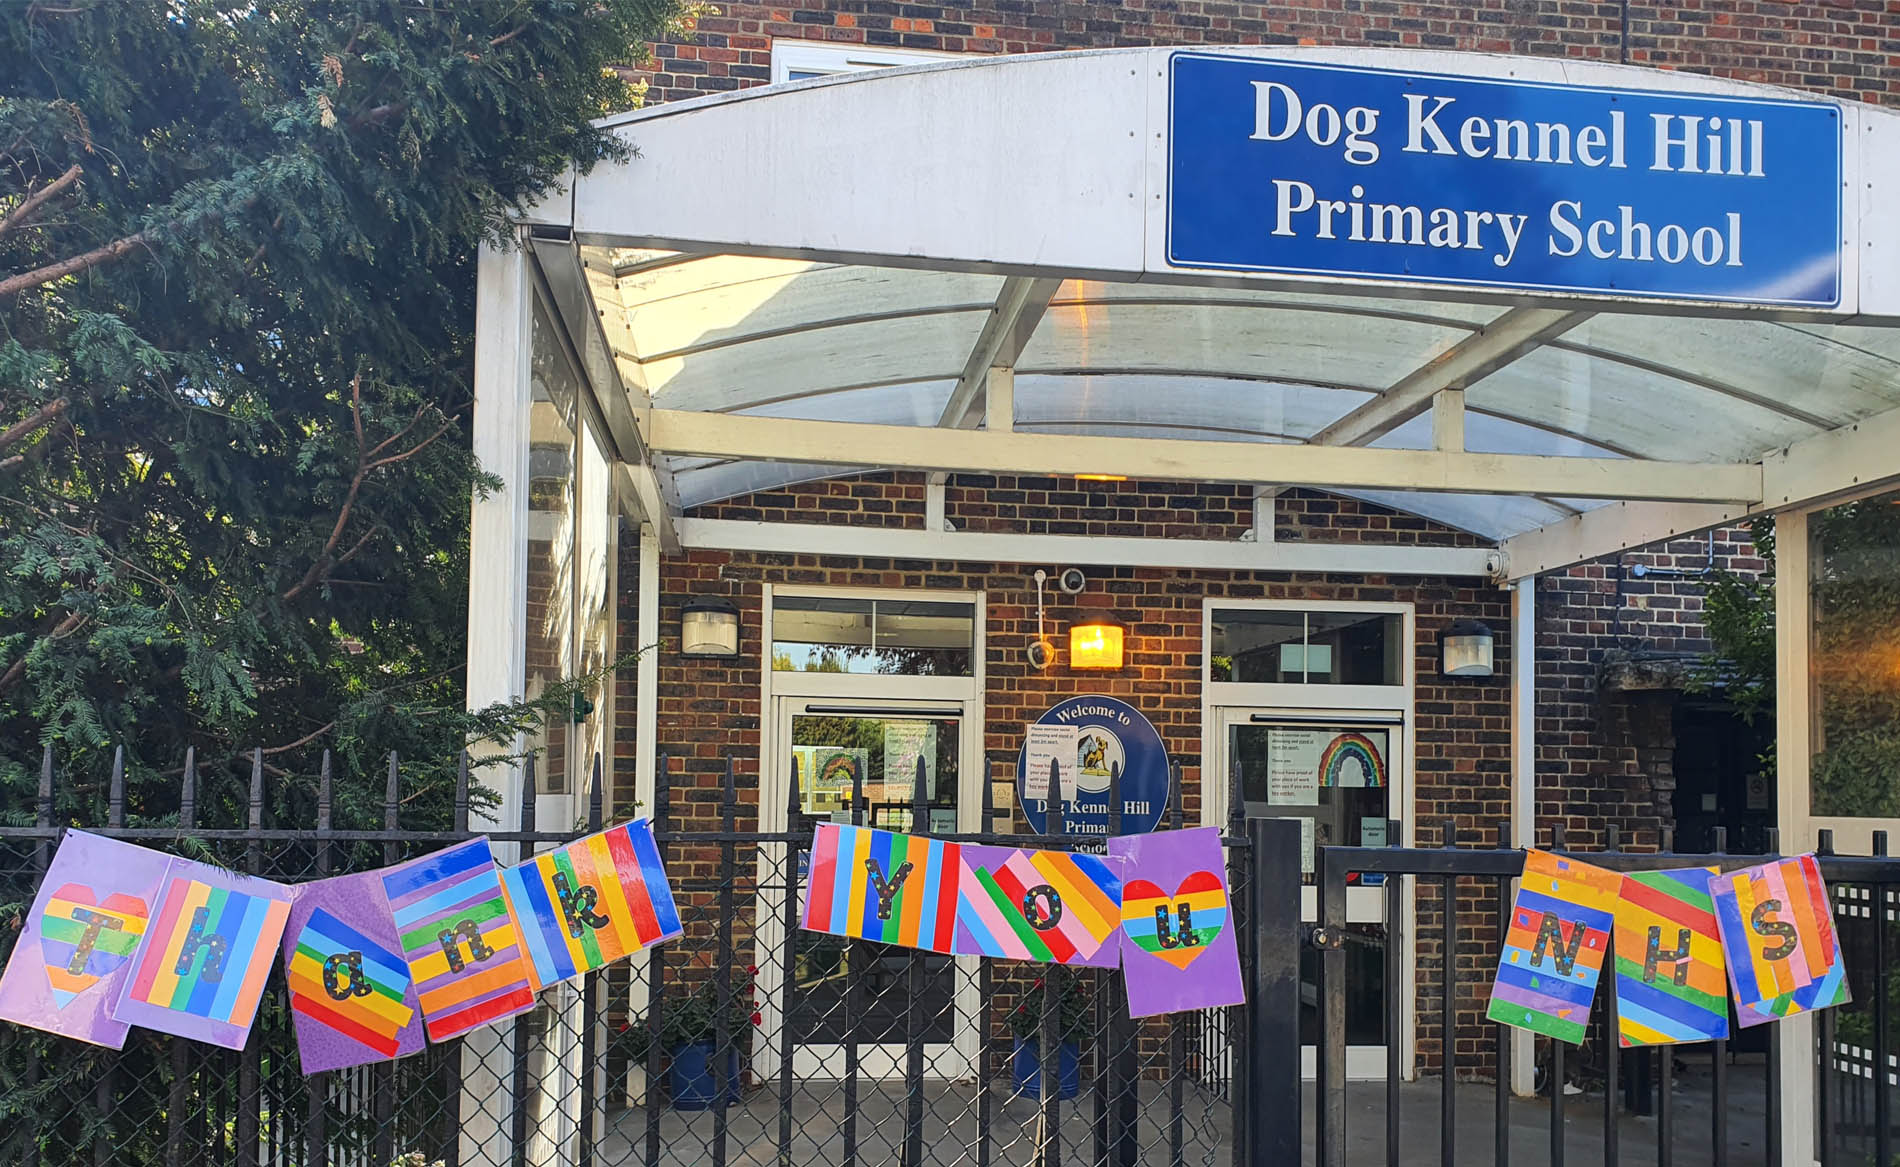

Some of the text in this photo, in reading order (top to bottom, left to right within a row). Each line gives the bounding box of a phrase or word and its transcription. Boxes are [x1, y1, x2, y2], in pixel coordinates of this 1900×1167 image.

[1249, 79, 1767, 178] Dog Kennel Hill
[1270, 178, 1745, 268] Primary School
[1055, 704, 1131, 726] Welcome to
[1124, 801, 1150, 815] Hill
[1530, 899, 1797, 986] NHS
